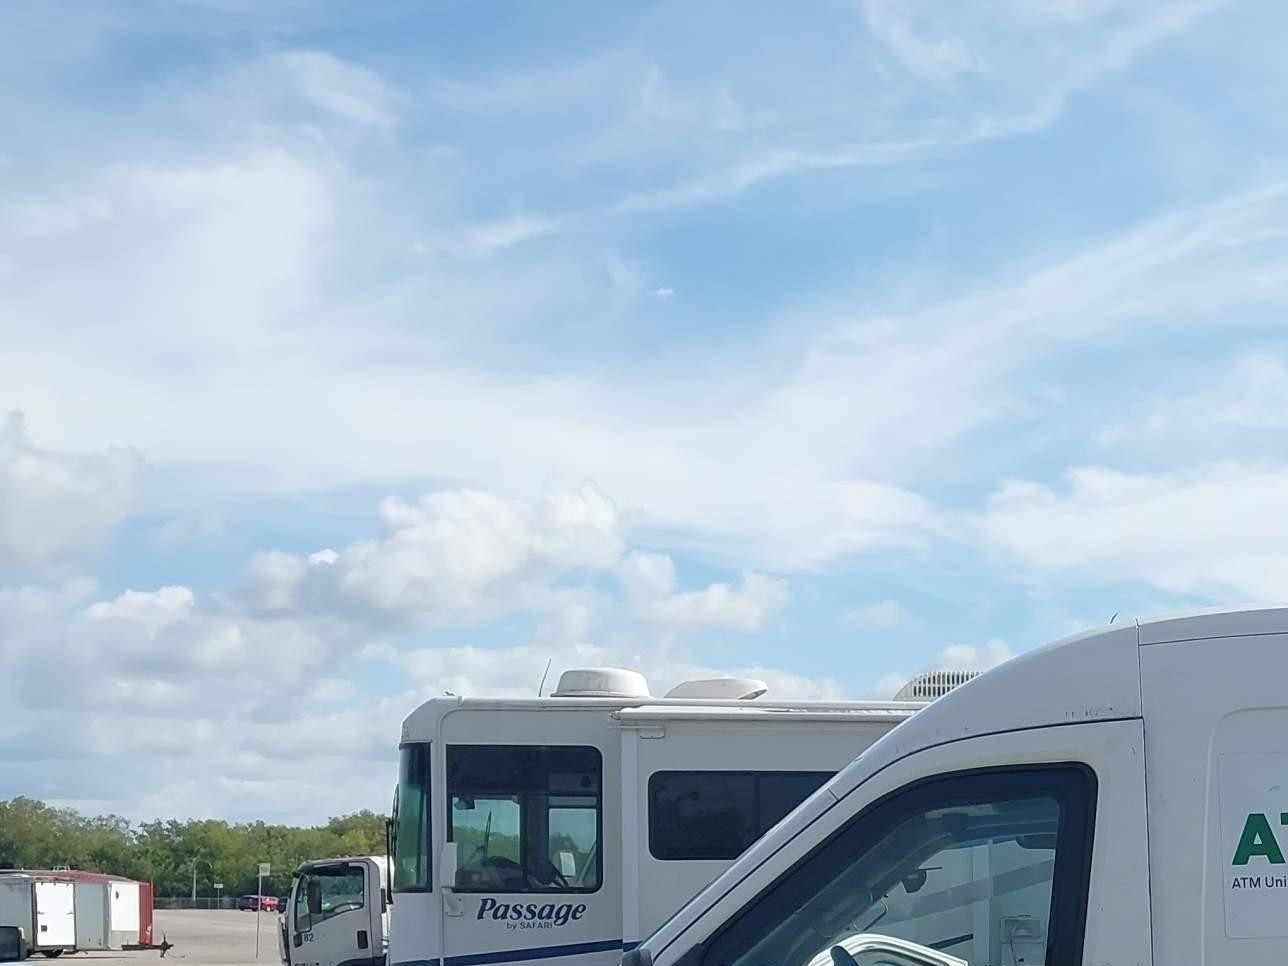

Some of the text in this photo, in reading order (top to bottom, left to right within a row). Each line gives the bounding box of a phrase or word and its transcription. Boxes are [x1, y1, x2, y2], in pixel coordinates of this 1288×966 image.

[1231, 877, 1261, 889] ATM
[477, 897, 587, 927] Passage
[506, 921, 553, 930] by SAFARI
